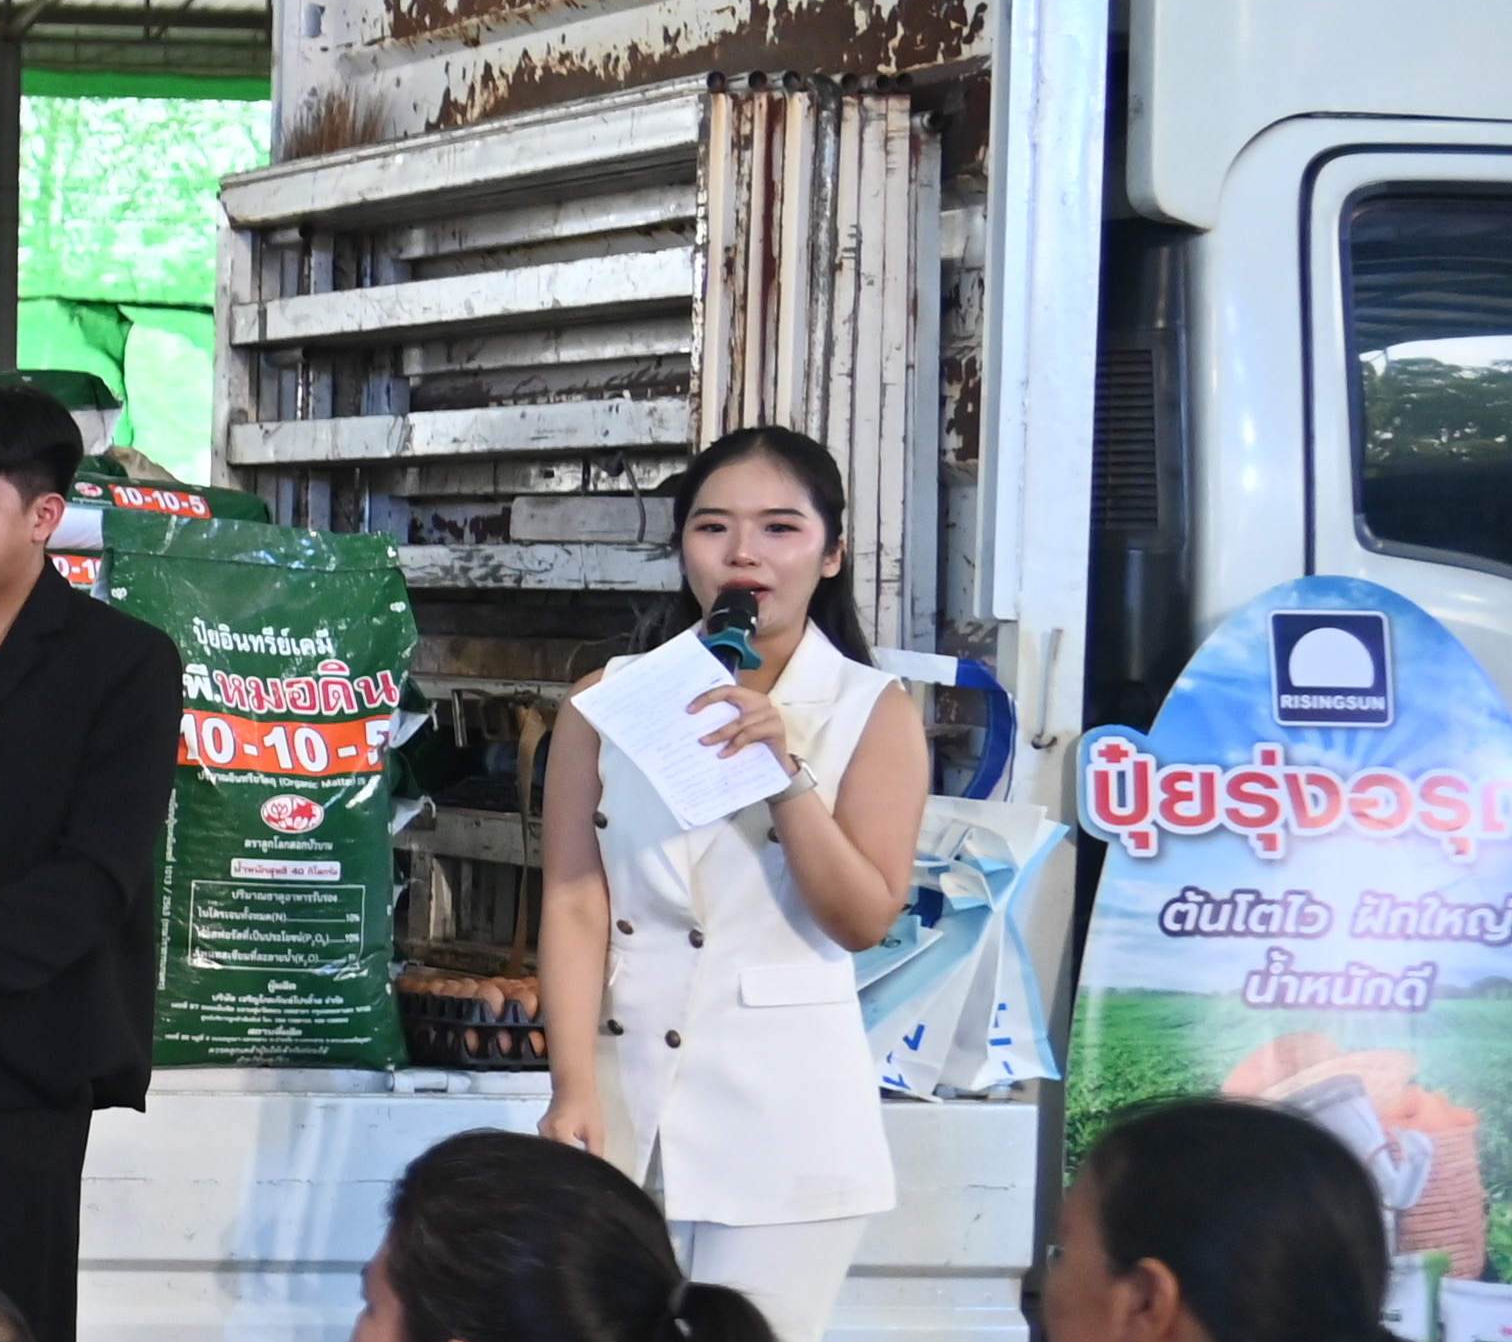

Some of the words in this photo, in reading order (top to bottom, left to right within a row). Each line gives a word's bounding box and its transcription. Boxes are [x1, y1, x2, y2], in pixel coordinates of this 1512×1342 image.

[114, 486, 206, 515] 10-10-5
[193, 617, 334, 656] ปุ๋ยอินทรีย์เคมี
[183, 659, 400, 716] .พี.หมอดิน
[1281, 695, 1385, 711] RISINGSUN
[1164, 887, 1329, 934] ต้นโตไว
[1246, 949, 1433, 1008] น้ำหนักดี
